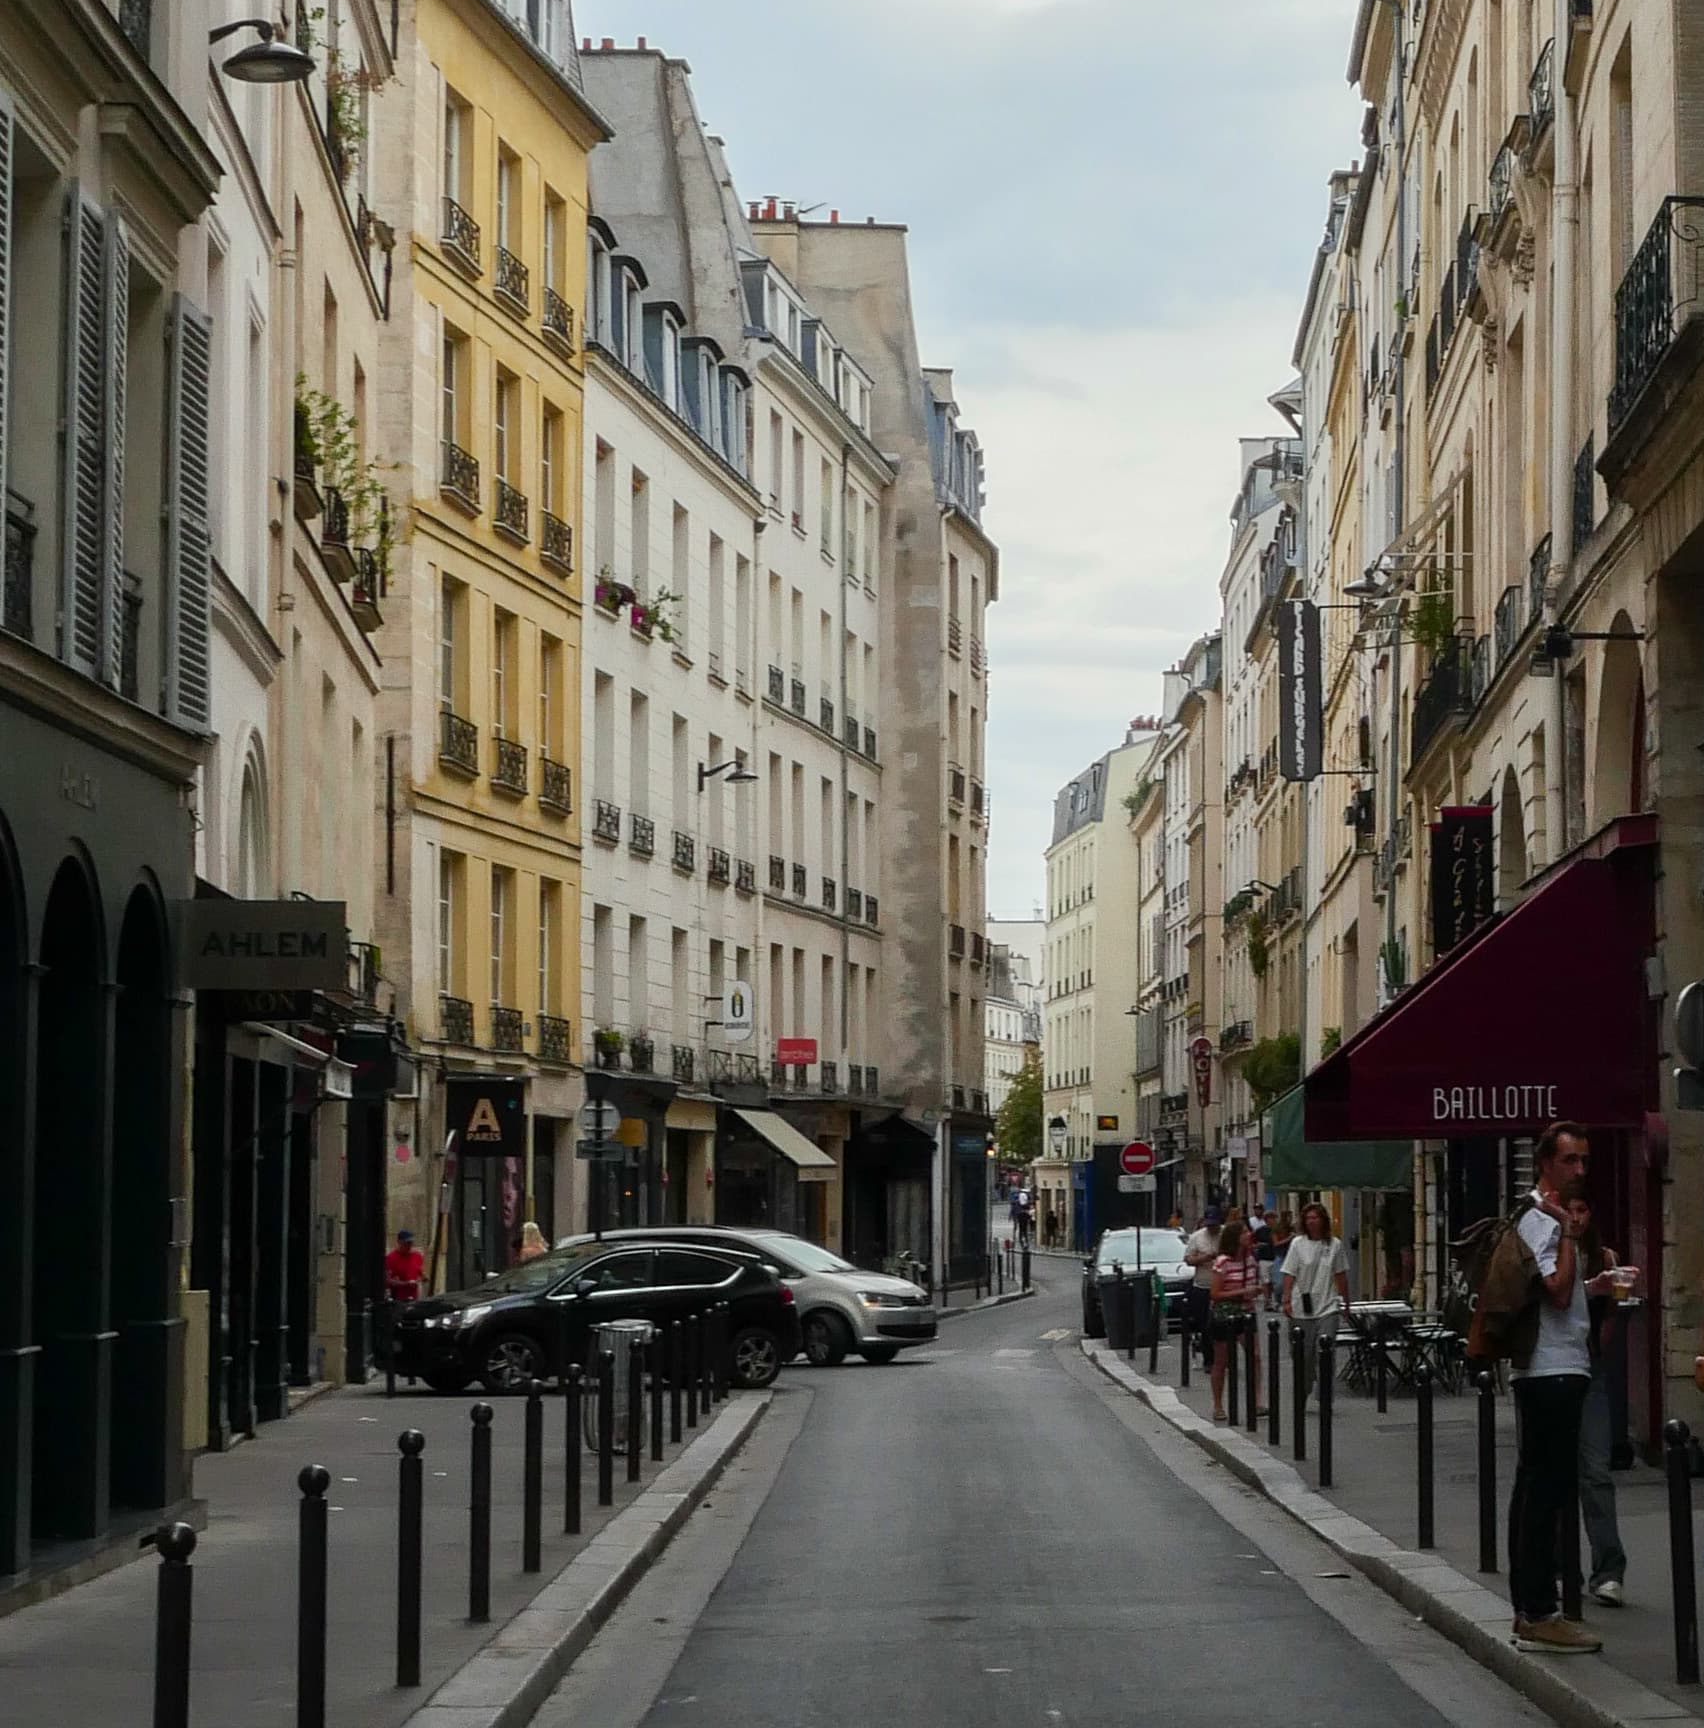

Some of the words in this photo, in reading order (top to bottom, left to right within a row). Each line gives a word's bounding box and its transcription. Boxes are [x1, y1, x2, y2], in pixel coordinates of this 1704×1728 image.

[202, 931, 327, 958] AHLEM
[467, 1098, 501, 1133] A
[1433, 1085, 1558, 1120] BAILLOTTE
[465, 1132, 502, 1142] PARIS
